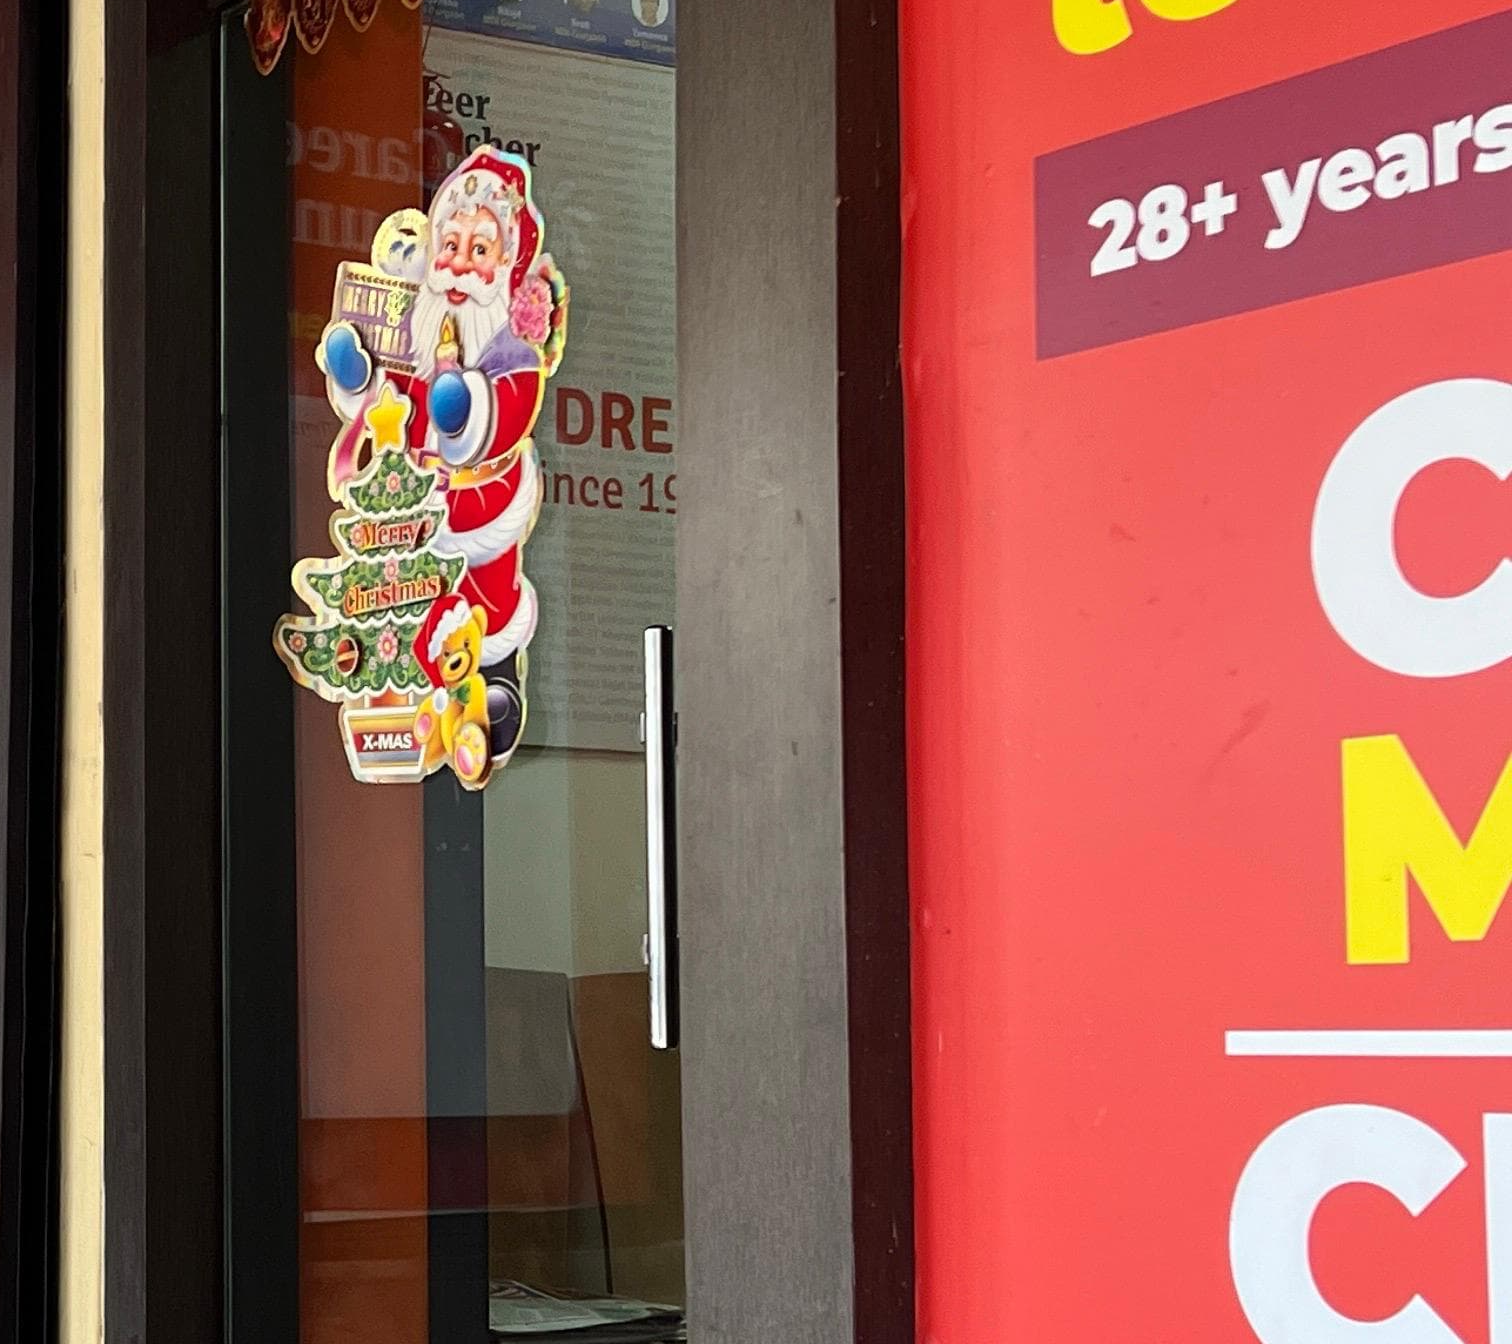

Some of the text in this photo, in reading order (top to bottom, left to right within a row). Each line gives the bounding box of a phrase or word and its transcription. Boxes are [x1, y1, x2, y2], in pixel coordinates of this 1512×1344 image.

[1087, 101, 1512, 277] 28+ years
[556, 387, 674, 454] DRE
[541, 459, 624, 510] ince
[361, 522, 418, 549] Merry
[1310, 377, 1512, 678] C
[344, 575, 440, 615] Christmas
[1341, 734, 1512, 964] M
